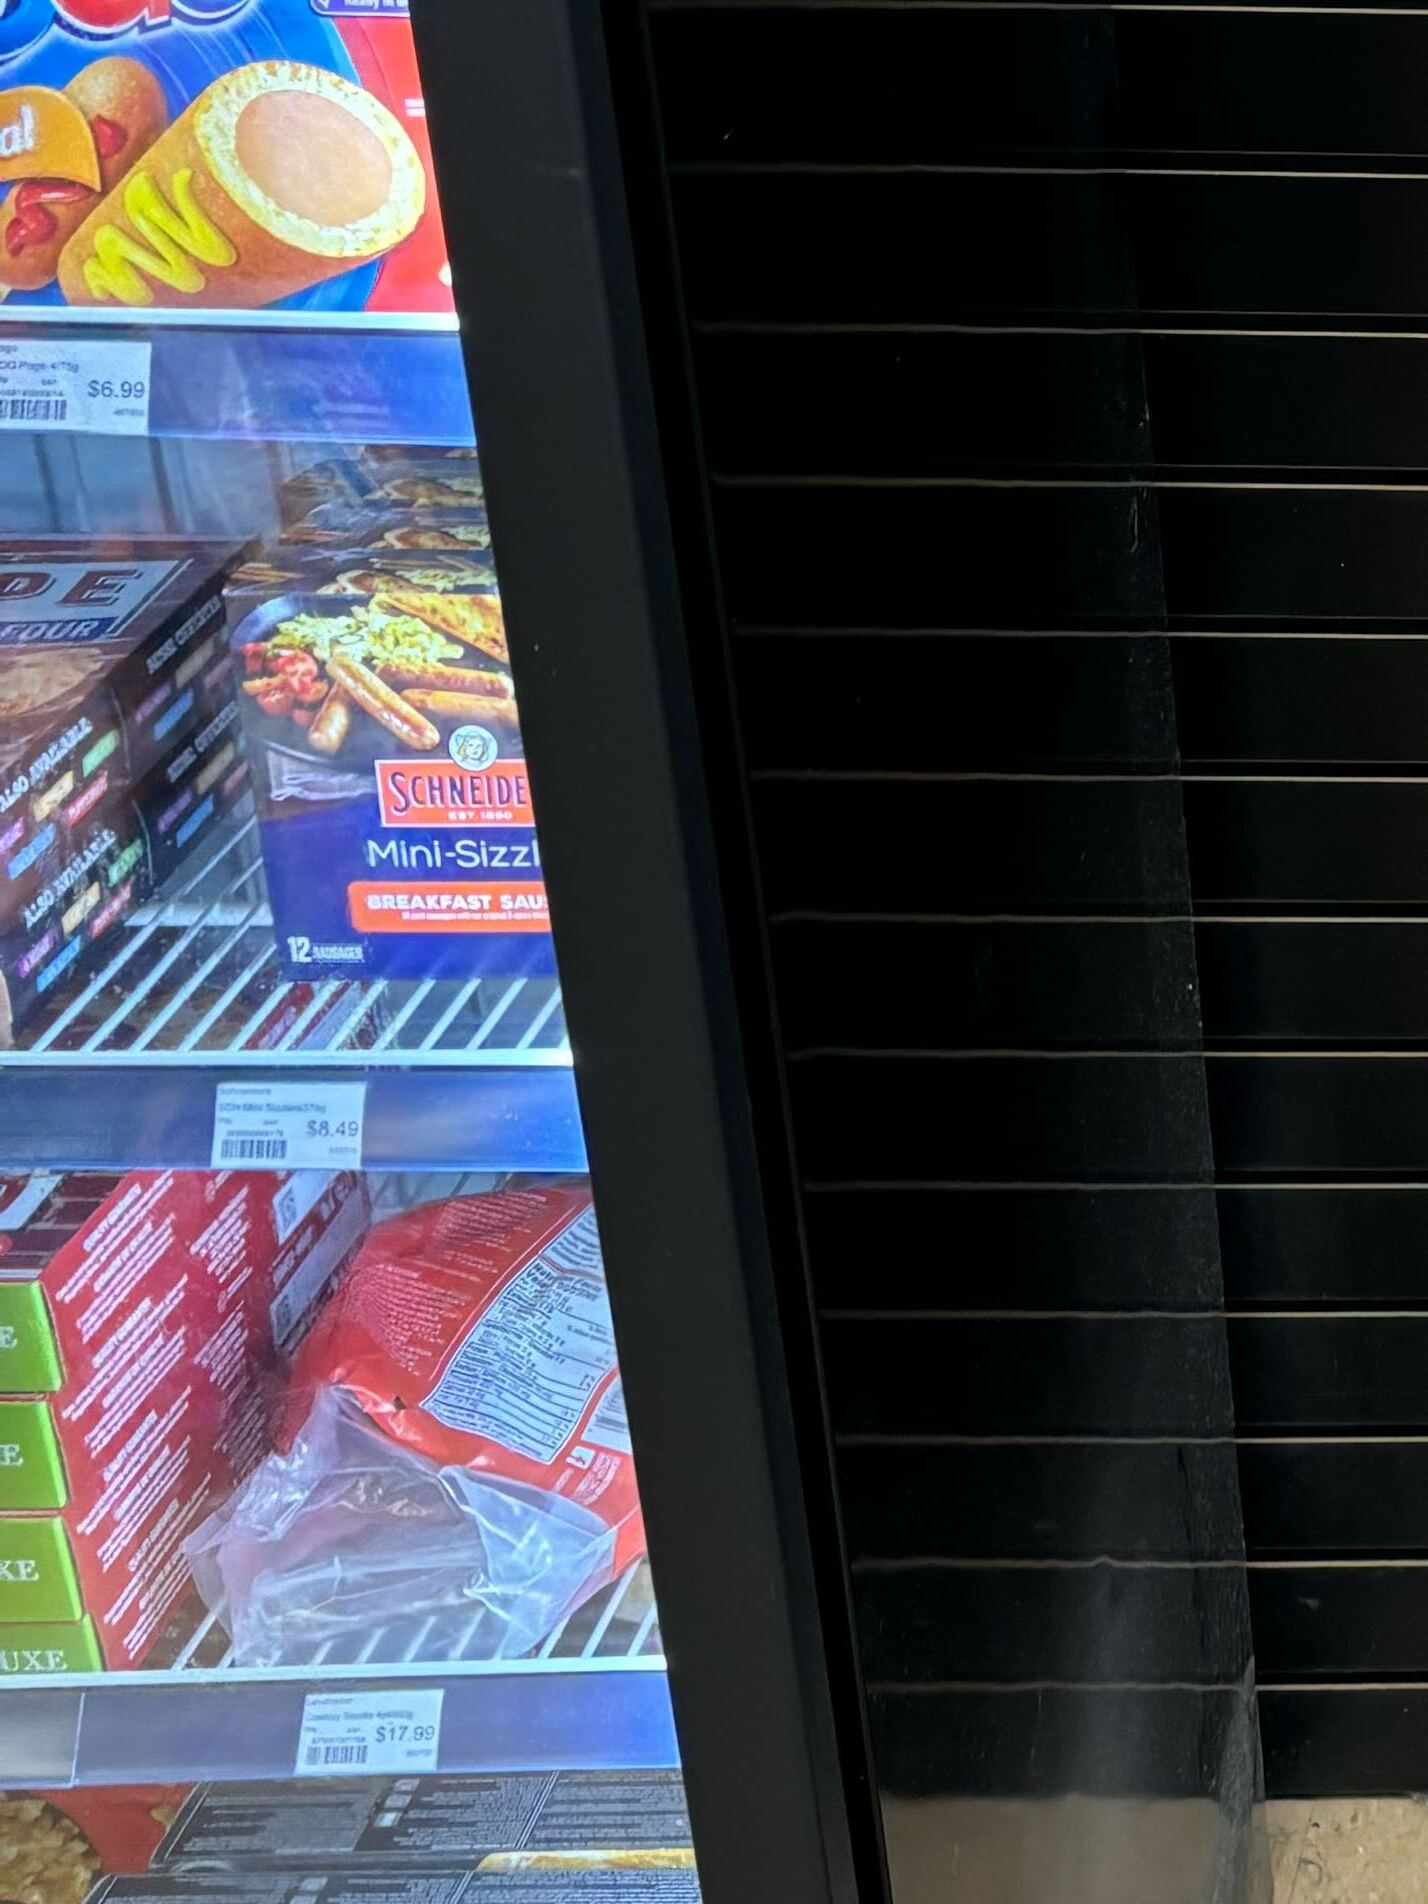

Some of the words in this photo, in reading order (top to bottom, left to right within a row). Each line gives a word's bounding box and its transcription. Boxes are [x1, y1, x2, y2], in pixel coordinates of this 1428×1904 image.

[87, 380, 145, 398] $6.99
[367, 840, 540, 868] Mini-Sizzl
[367, 894, 492, 910] BREAKFAST
[288, 937, 312, 963] 12
[306, 1119, 358, 1137] $8.49
[376, 1726, 435, 1743] $17.99
